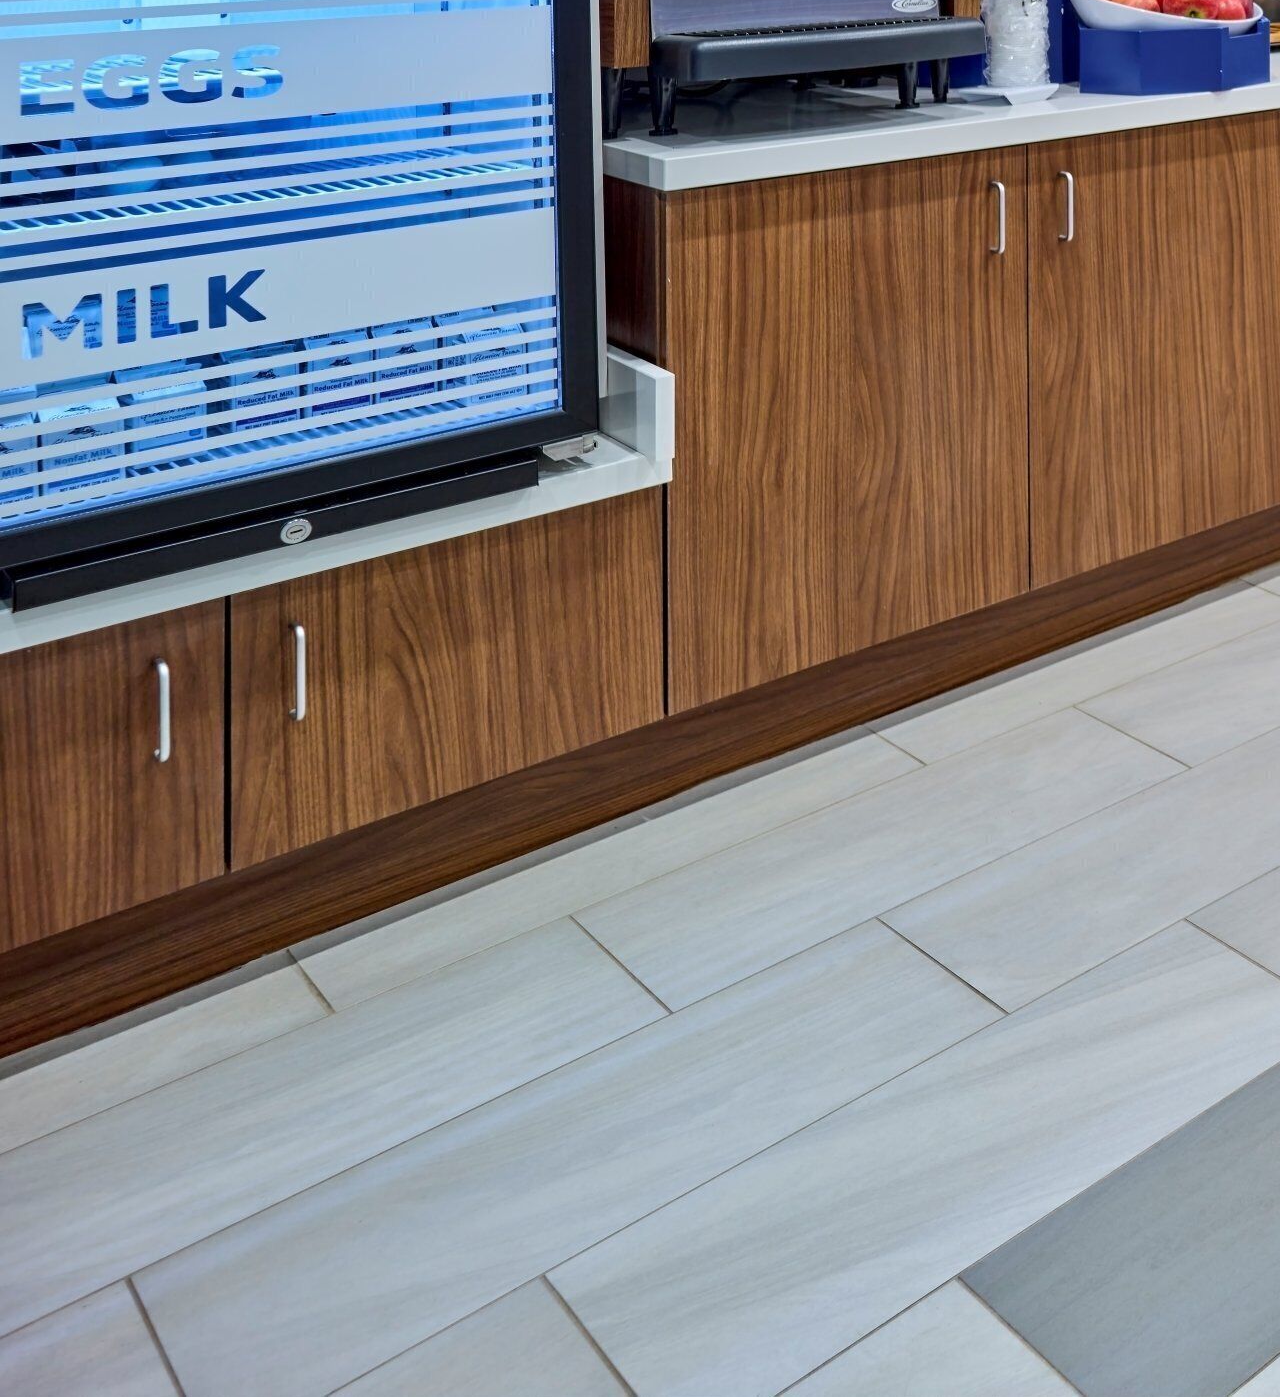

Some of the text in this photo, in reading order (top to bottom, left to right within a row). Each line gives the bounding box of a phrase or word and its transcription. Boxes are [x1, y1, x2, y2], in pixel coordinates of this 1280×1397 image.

[19, 44, 284, 117] EGGS
[22, 268, 267, 360] MILK
[381, 369, 408, 379] Reduced
[419, 364, 433, 372] Milk
[314, 377, 369, 392] Reduced Fat Milk
[237, 395, 266, 406] Reduced
[280, 390, 295, 398] Milk
[54, 447, 113, 466] Nonfat Milk
[2, 466, 25, 478] Milk
